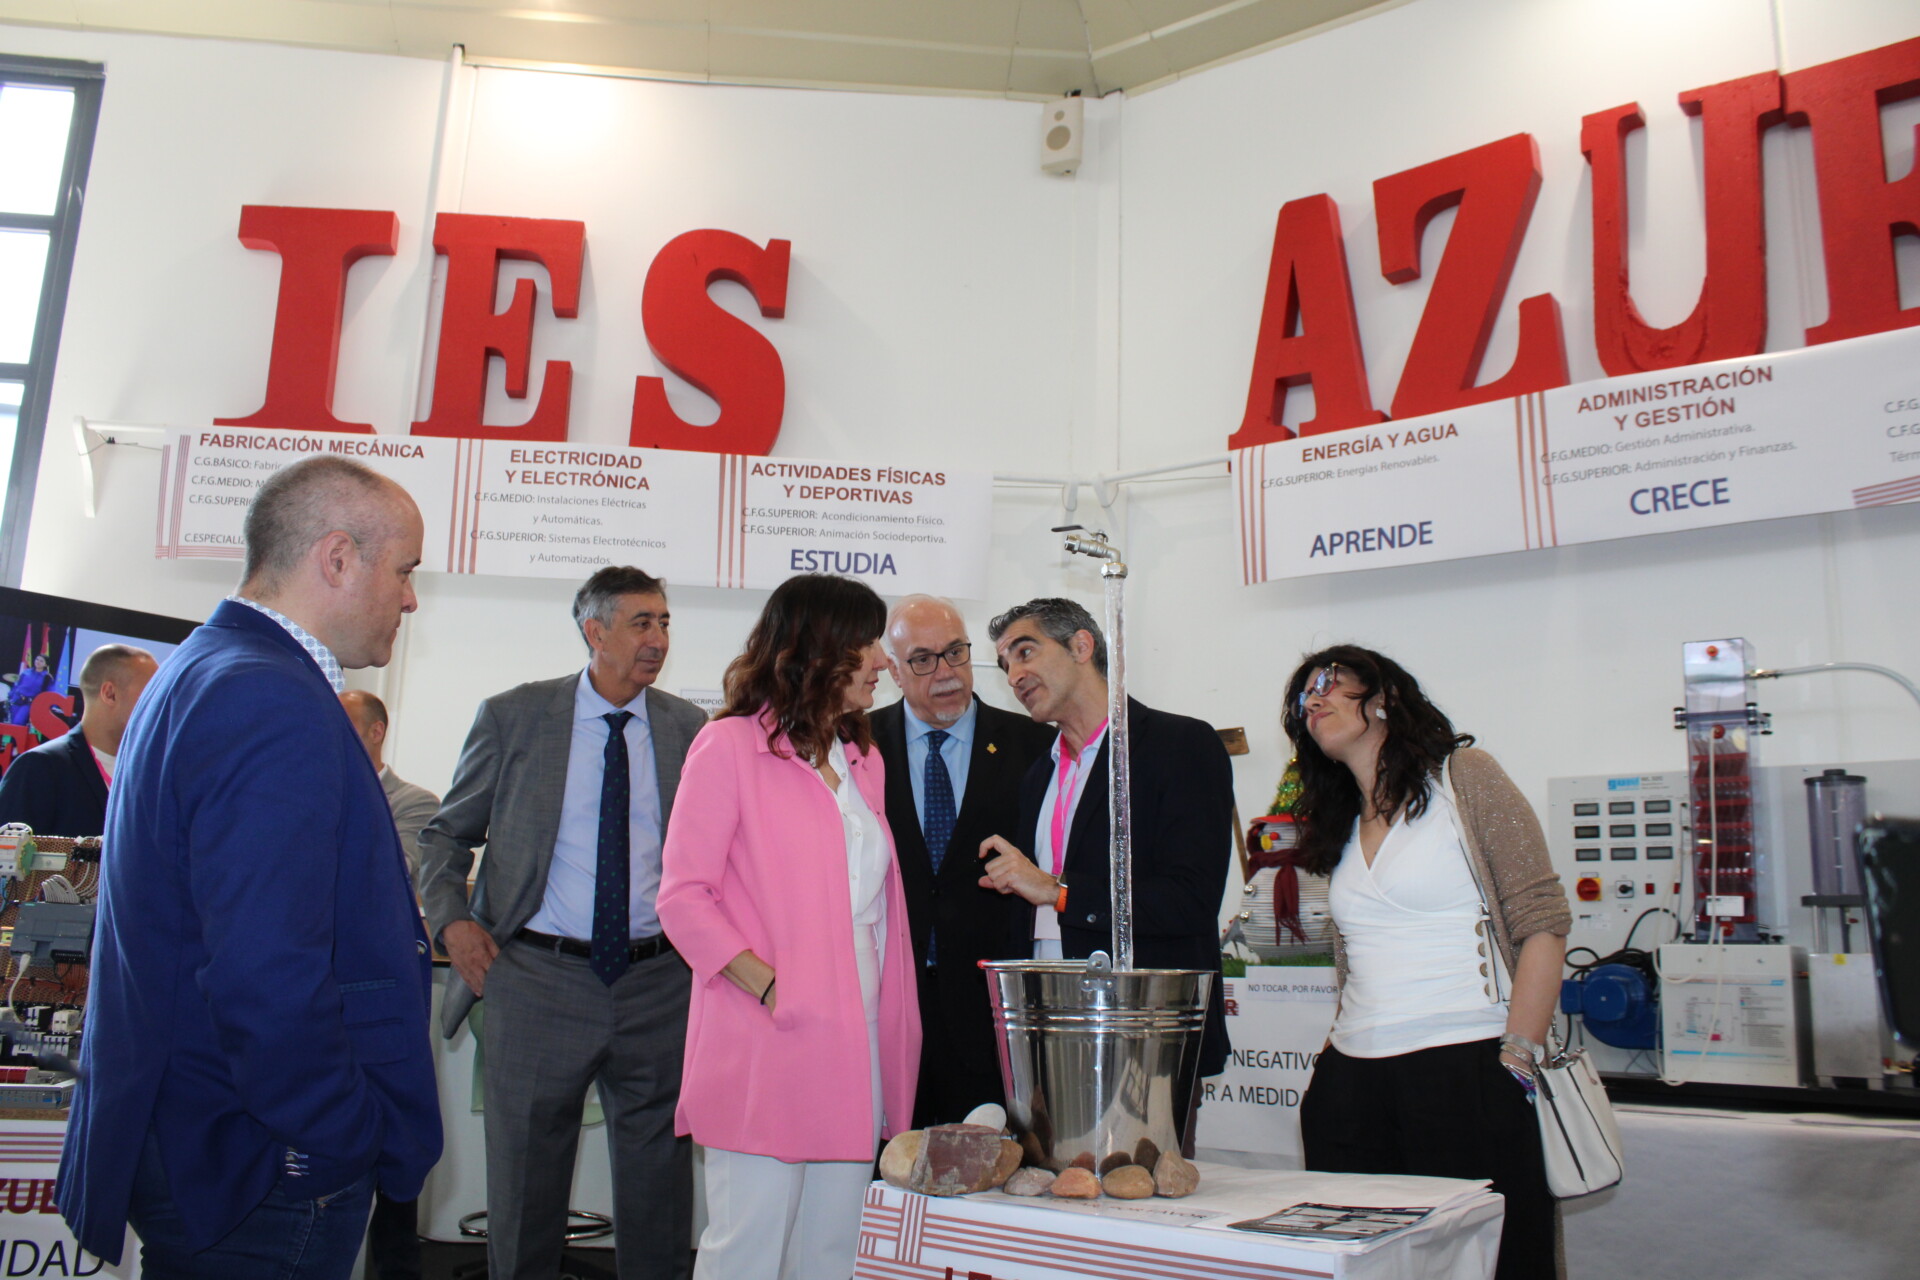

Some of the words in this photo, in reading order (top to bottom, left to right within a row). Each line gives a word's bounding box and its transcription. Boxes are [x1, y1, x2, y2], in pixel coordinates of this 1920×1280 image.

[213, 204, 792, 456] IES
[1577, 365, 1773, 414] ADMINISTRACIÓN
[1614, 414, 1628, 431] Y
[1635, 397, 1736, 428] GESTIÓN
[199, 433, 323, 452] FABRICACIÓN
[328, 439, 425, 458] MECÁNICA
[1302, 434, 1383, 463] ENERGÍA
[1387, 433, 1400, 448] Y
[1403, 423, 1459, 446] AGUA
[1541, 444, 1613, 464] C.F.G.MEDIO:
[1615, 436, 1660, 453] Gestión
[1664, 424, 1756, 444] Administrativa.
[510, 449, 642, 469] ELECTRICIDAD
[1542, 464, 1632, 486] C.F.G.SUPERIOR:
[1634, 450, 1726, 473] Administración
[1728, 449, 1736, 461] y
[1739, 440, 1798, 457] Finanzas.
[191, 475, 253, 488] C.F.G.MEDIO:
[505, 470, 517, 483] Y
[521, 470, 650, 490] ELECTRÓNICA
[751, 462, 871, 482] ACTIVIDADES
[877, 467, 946, 486] FÍSICAS
[1261, 471, 1335, 489] C.F.G.SUPERIOR:
[1380, 454, 1440, 472] Renovables.
[474, 492, 536, 504] C.F.G.MEDIO:
[537, 495, 599, 507] Instalaciones
[601, 497, 647, 509] Eléctricas
[783, 484, 795, 498] Y
[800, 485, 913, 505] DEPORTIVAS
[1630, 477, 1731, 515] CRECE
[533, 515, 540, 525] y
[541, 514, 603, 526] Automáticas.
[742, 507, 818, 520] C.F.G.SUPERIOR:
[821, 511, 915, 525] Acondicionamiento
[916, 515, 945, 526] Físico.
[470, 530, 547, 543] C.F.G.SUPERIOR:
[548, 534, 591, 545] Sistemas
[593, 535, 666, 549] Electrotécnicos
[741, 524, 817, 537] C.F.G.SUPERIOR:
[819, 529, 870, 540] Animación
[873, 531, 947, 545] Sociodeportiva.
[1309, 520, 1434, 558] APRENDE
[529, 554, 536, 564] y
[538, 553, 613, 566] Automatizados.
[790, 548, 897, 575] ESTUDIA
[1248, 984, 1260, 992] NO
[1262, 984, 1290, 993] TOCAR,
[1292, 985, 1309, 993] POR
[1310, 985, 1338, 994] FAVOR
[1221, 1084, 1233, 1102] A
